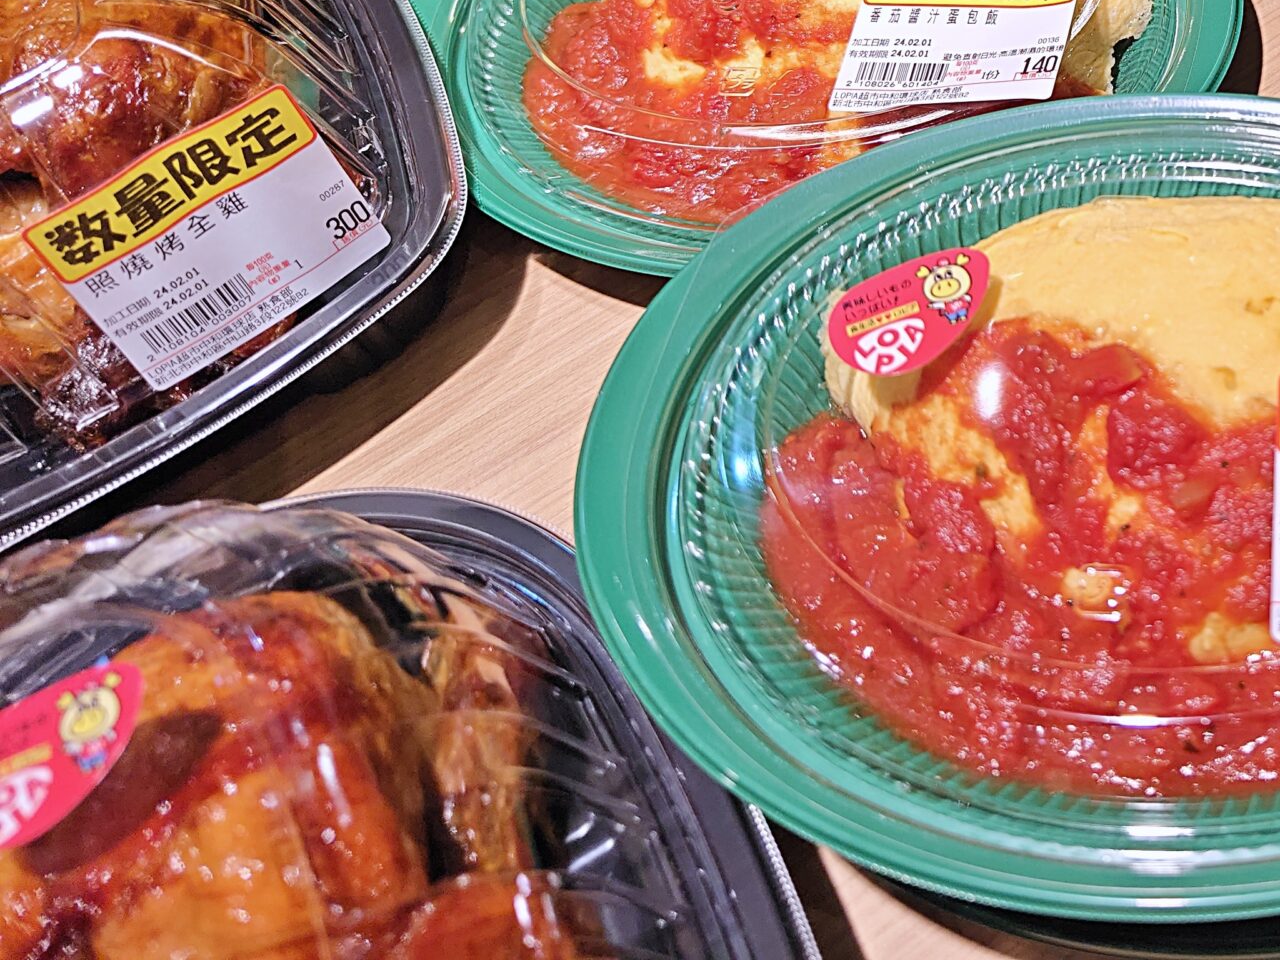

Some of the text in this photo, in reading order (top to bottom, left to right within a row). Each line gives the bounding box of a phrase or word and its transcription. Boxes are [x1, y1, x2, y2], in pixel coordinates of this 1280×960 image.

[870, 8, 999, 25] 番茄醬汁蛋包飯
[1021, 56, 1058, 74] 140
[44, 107, 297, 266] 数量限定
[319, 180, 345, 201] 00287
[326, 201, 370, 239] 300
[85, 191, 249, 298] 照燒烤全雞
[103, 267, 200, 328] 加工日期 24.02.01
[163, 279, 209, 310] 24.02.01
[162, 327, 206, 354] 108104
[211, 296, 252, 326] 003007
